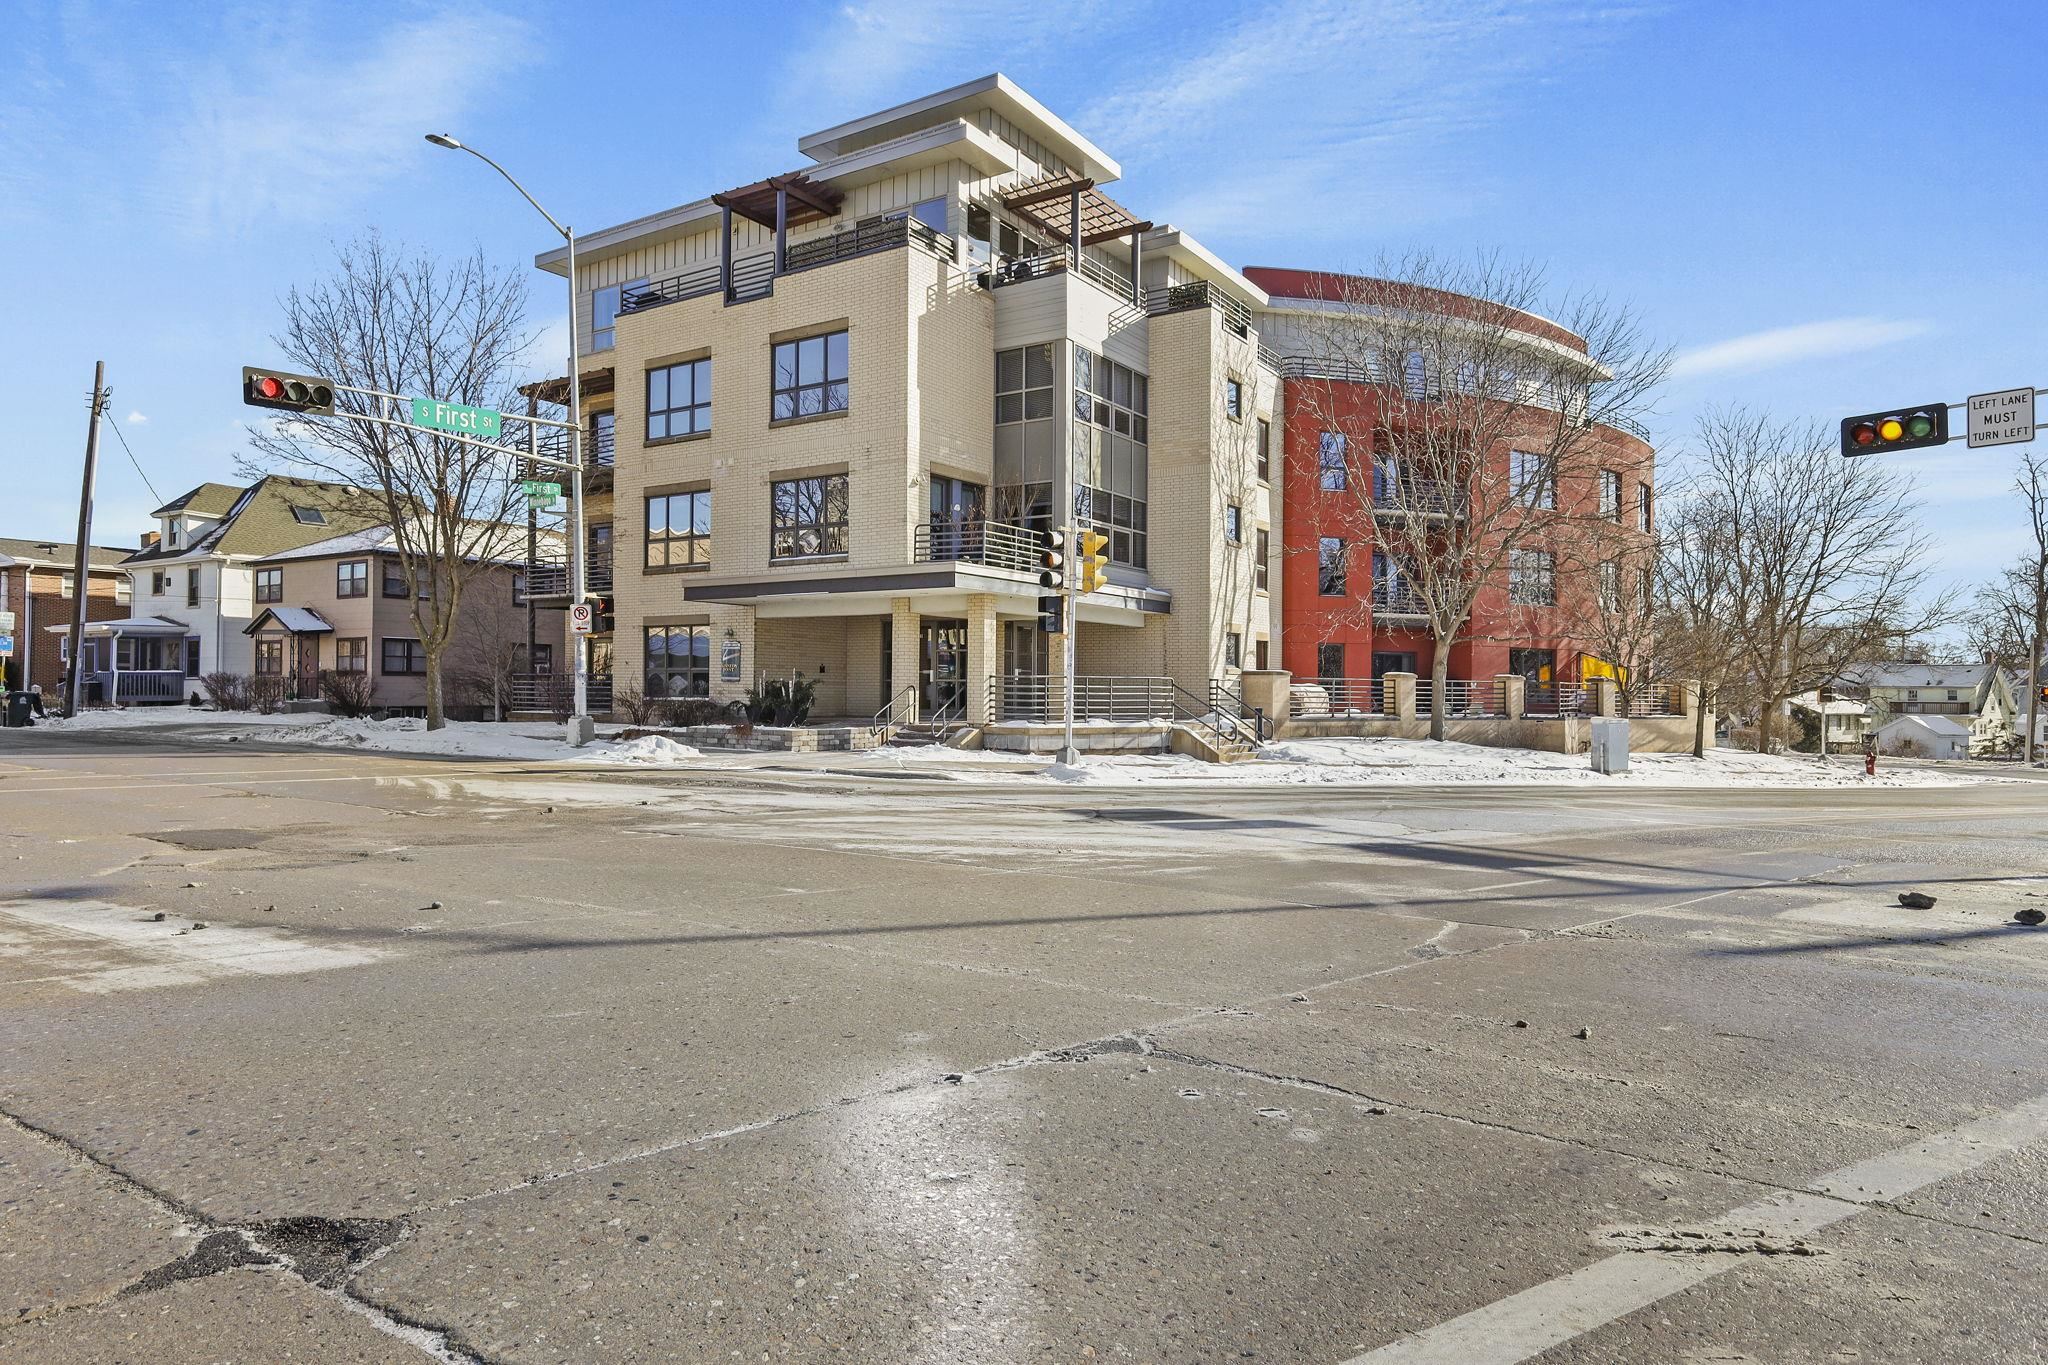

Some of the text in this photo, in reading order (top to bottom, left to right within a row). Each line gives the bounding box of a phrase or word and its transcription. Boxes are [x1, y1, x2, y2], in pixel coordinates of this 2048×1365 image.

[1973, 393, 2029, 410] LEFT LANE
[422, 403, 493, 429] S First St
[1984, 411, 2017, 425] MUST
[1973, 426, 2029, 442] TURN LEFT
[532, 483, 551, 494] First
